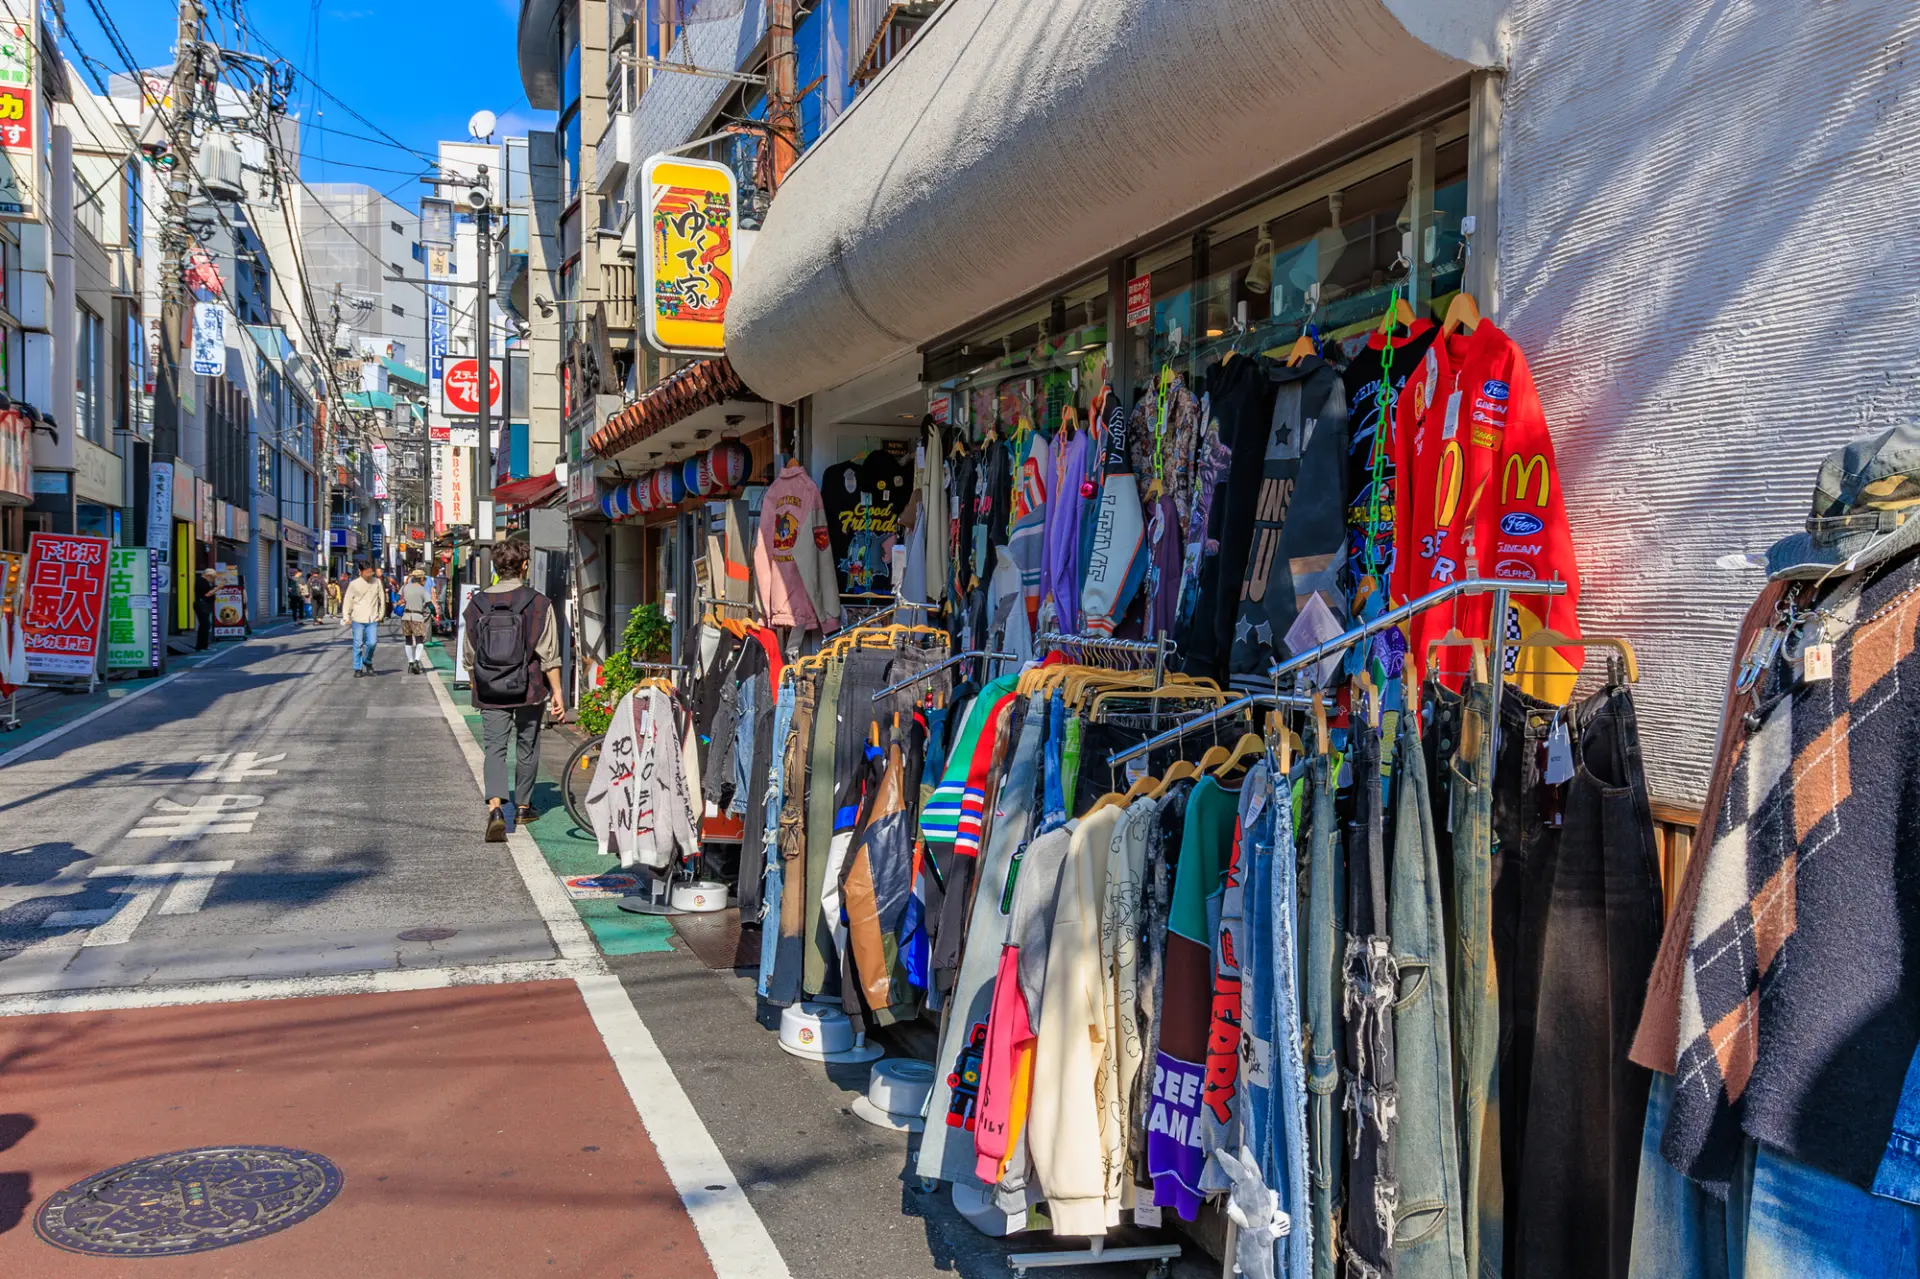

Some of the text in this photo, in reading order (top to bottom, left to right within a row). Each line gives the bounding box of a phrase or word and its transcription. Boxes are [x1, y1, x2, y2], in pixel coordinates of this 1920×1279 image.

[1129, 307, 1149, 320] SECURITY
[36, 540, 101, 564] 下北沢
[26, 560, 98, 632] 最大
[108, 570, 136, 645] 古着屋
[23, 632, 93, 652] トレカ専門店
[216, 627, 243, 636] CAFE
